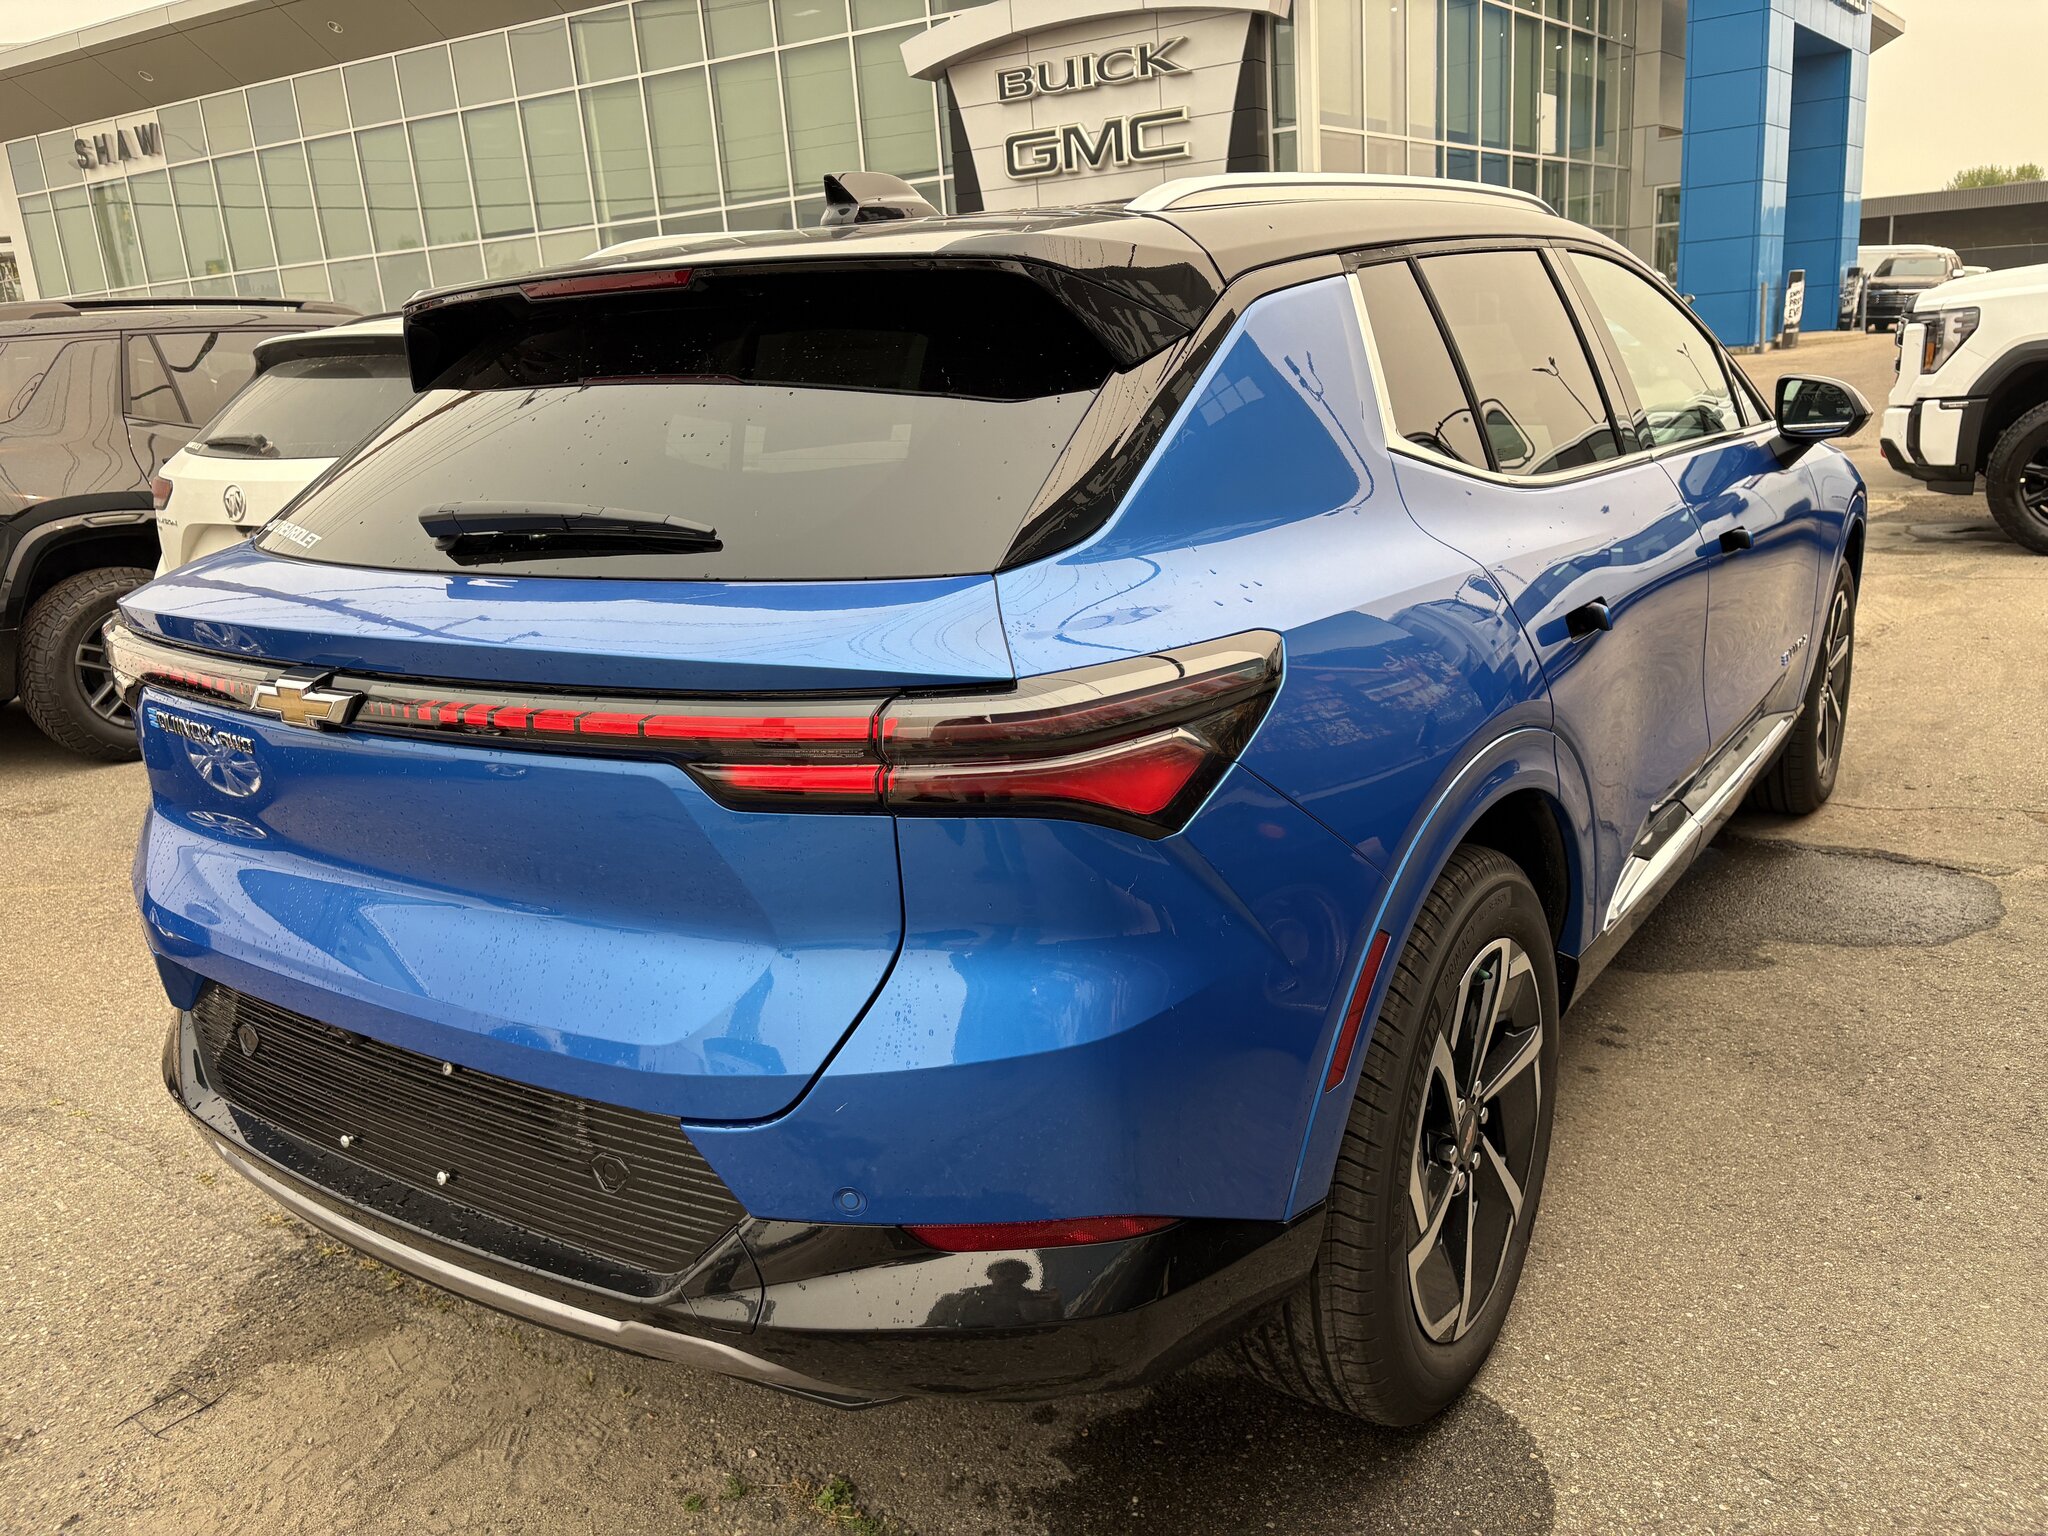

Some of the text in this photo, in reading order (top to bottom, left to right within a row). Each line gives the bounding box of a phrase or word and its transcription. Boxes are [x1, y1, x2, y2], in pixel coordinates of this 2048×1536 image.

[996, 36, 1192, 104] BUICK
[75, 122, 160, 169] SHAW
[1003, 106, 1191, 180] GMC
[274, 520, 322, 549] CHEVROLET
[147, 707, 217, 747] EQUINOX
[1443, 924, 1475, 990] PRIMACY
[1397, 1004, 1441, 1190] MICHELIN
